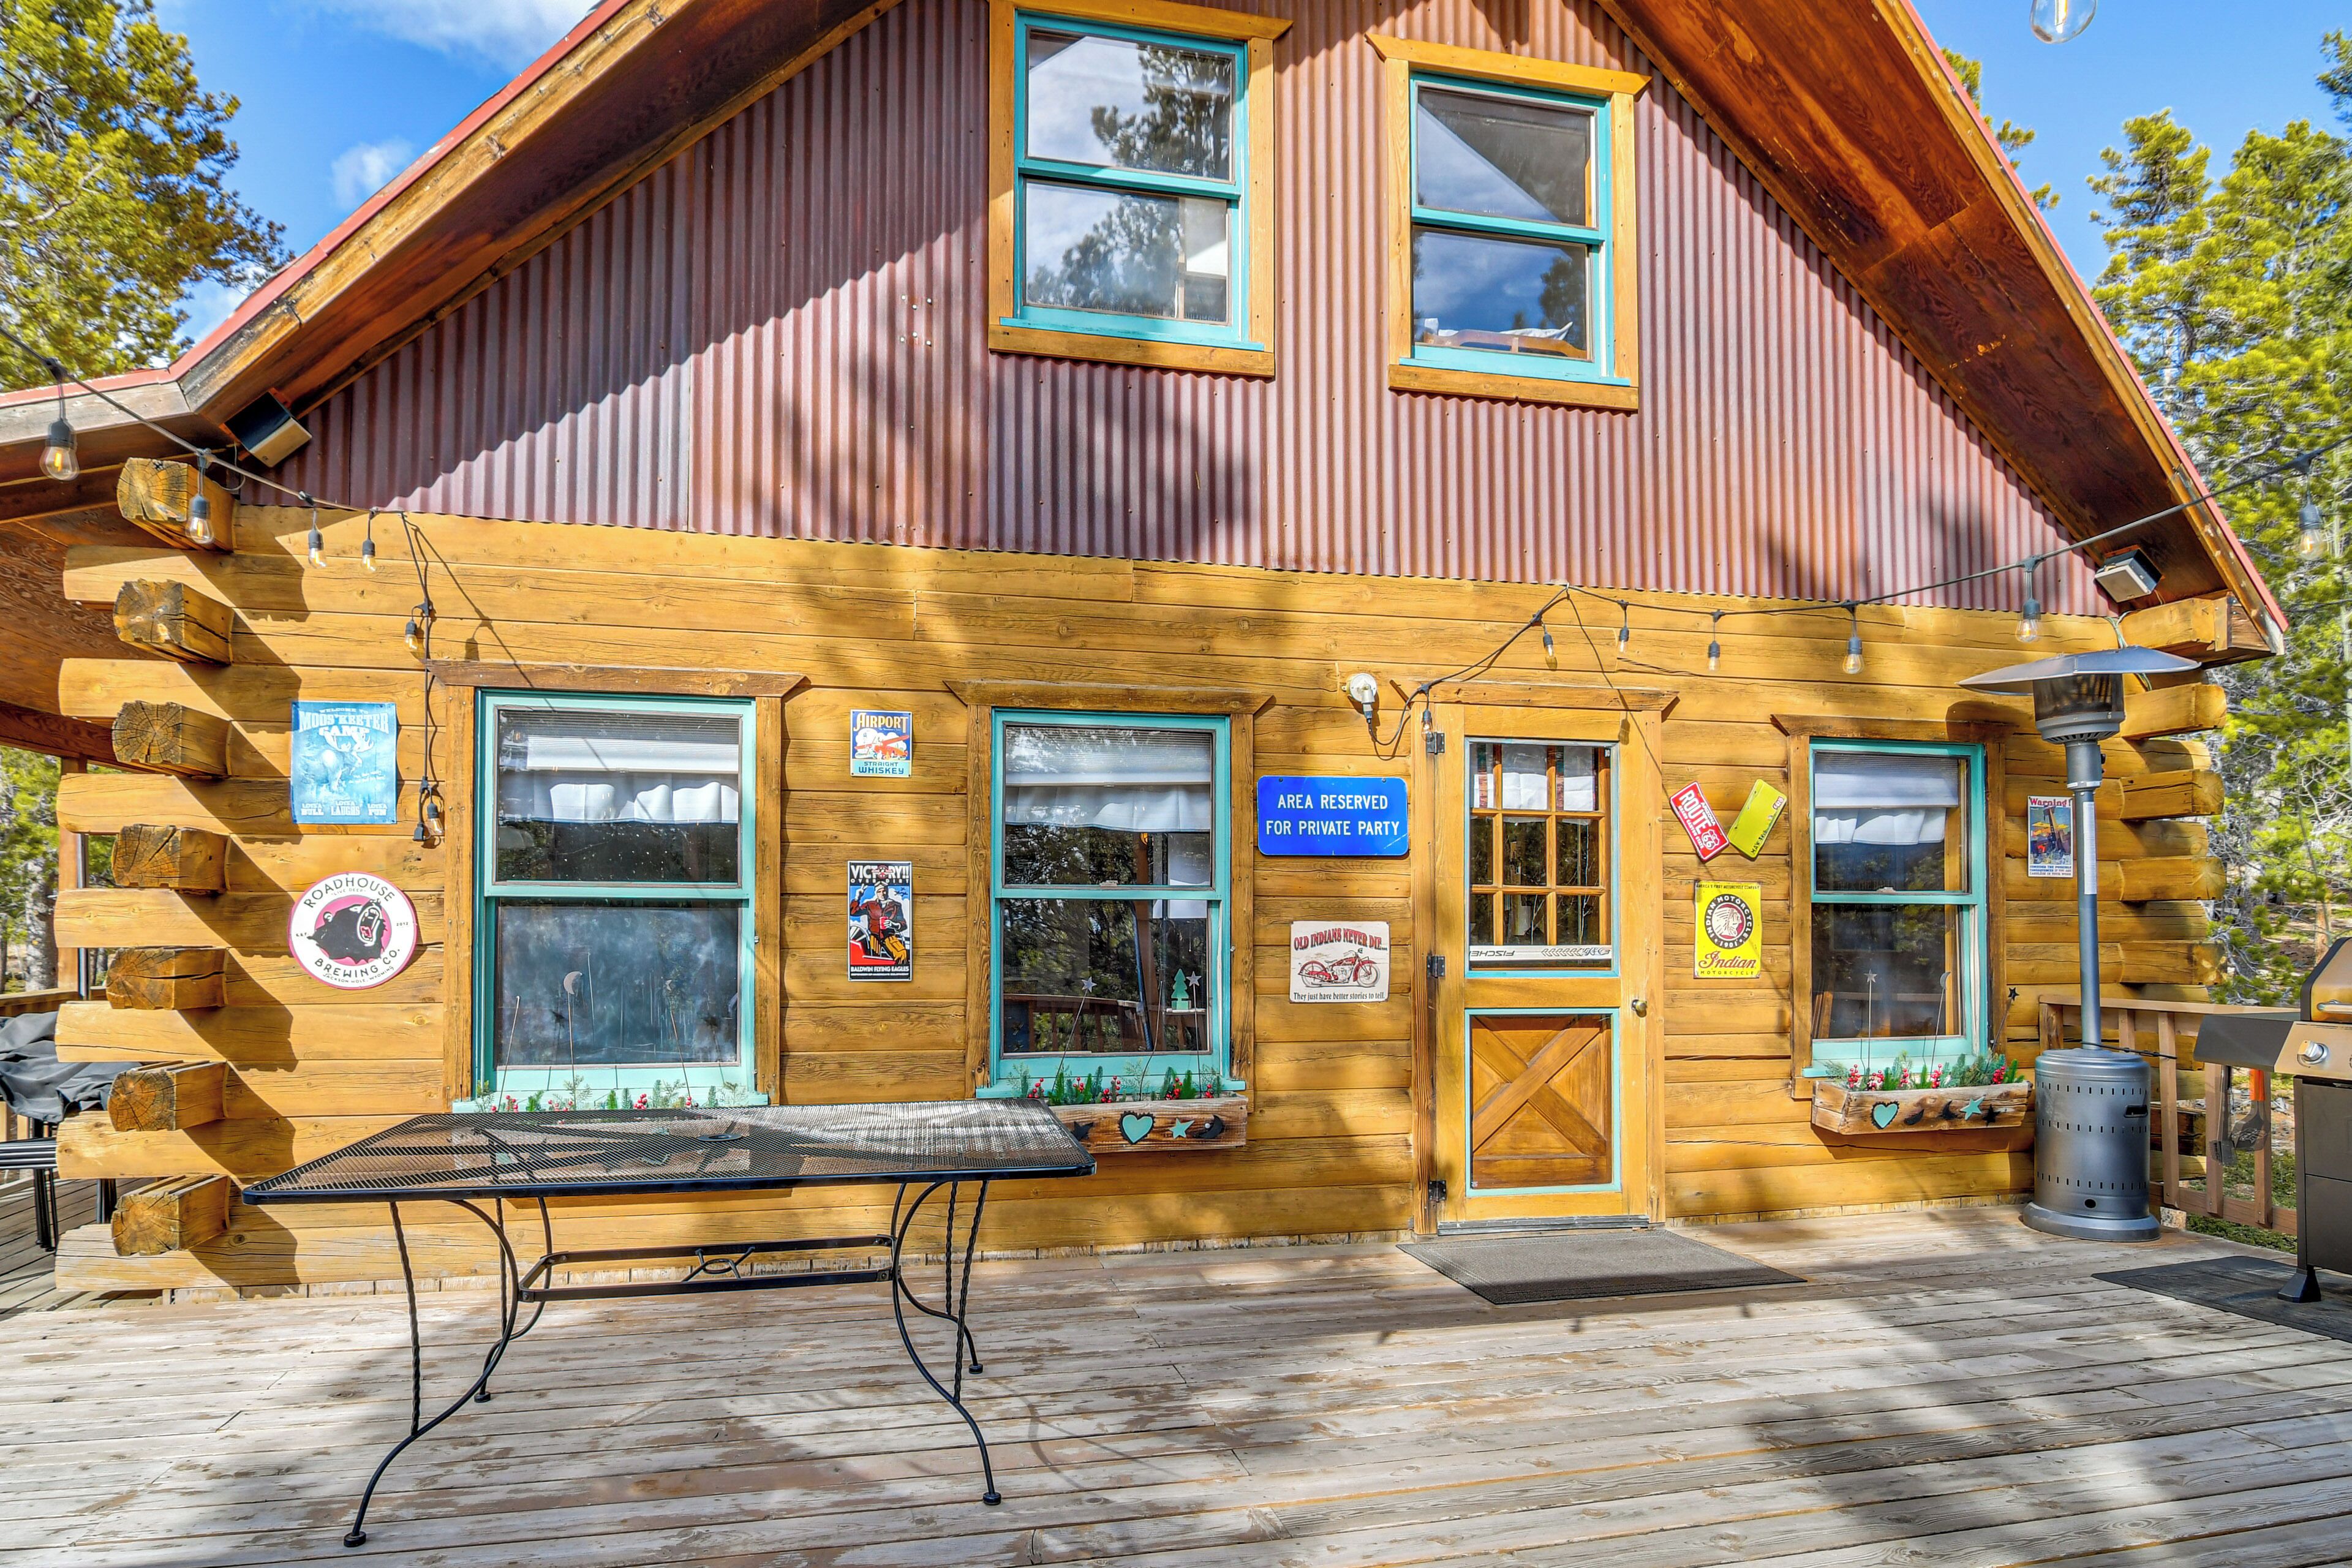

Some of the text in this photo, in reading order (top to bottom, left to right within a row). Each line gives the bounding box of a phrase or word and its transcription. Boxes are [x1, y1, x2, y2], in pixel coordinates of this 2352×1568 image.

[853, 712, 908, 733] AIRPORT
[1278, 794, 1388, 809] AREA RESERVED
[1679, 790, 1716, 850] ROUTE 66
[1700, 802, 1716, 826] ARIZONA
[1266, 820, 1400, 835] FOR PRIVATE PARTY
[303, 877, 396, 908] ROADHOUSE
[1706, 895, 1752, 940] INDIAN MOTORCYCLE
[1294, 936, 1309, 951] OLD
[1311, 928, 1342, 948] INDIANS
[1343, 928, 1368, 948] NEVER
[1720, 940, 1738, 948] 1901
[315, 949, 400, 978] BREWING CO.
[1699, 951, 1757, 968] Indian
[323, 973, 349, 983] JACKSON
[369, 965, 394, 980] WYOMING
[1294, 992, 1307, 1001] They
